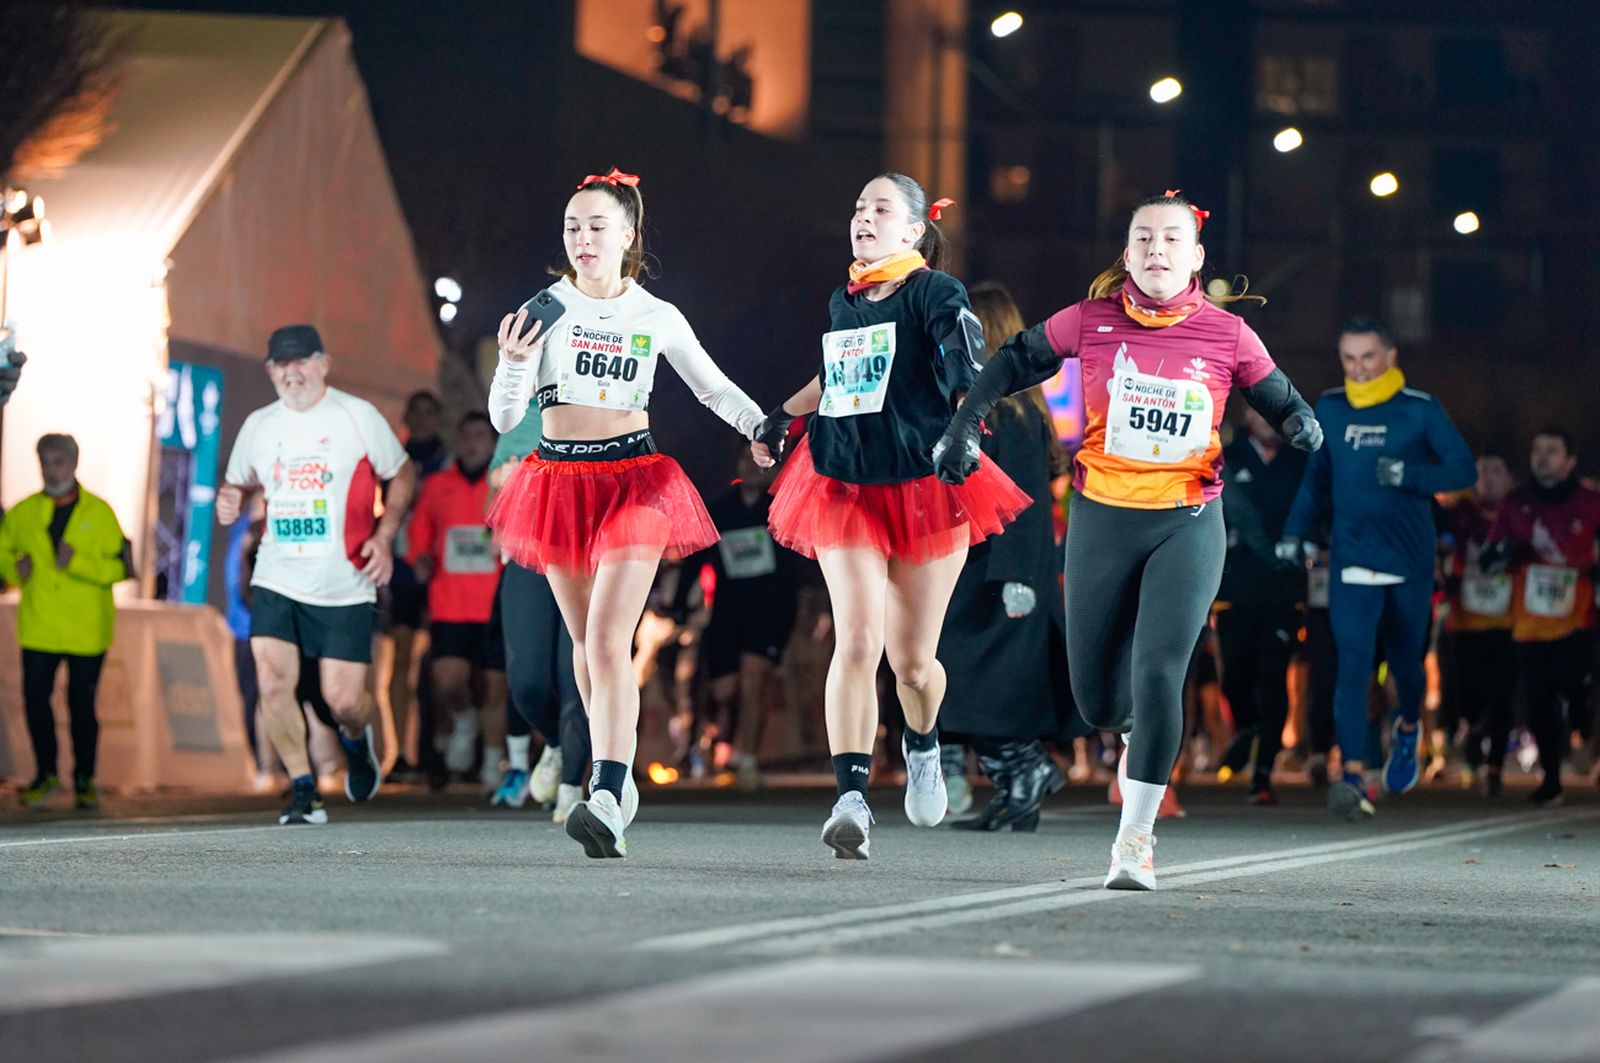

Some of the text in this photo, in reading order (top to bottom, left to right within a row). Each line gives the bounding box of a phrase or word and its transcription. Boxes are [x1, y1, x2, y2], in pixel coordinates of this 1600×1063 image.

[583, 331, 611, 343] NOCHE
[612, 336, 624, 344] DE
[570, 339, 590, 350] SAN
[591, 342, 623, 354] ANTÓN
[575, 350, 639, 382] 6640
[1135, 384, 1164, 396] NOCHE
[1165, 389, 1177, 399] DE
[1122, 392, 1141, 405] SAN
[1143, 395, 1177, 409] ANTÓN
[1129, 406, 1192, 437] 5947
[275, 517, 326, 536] 13883
